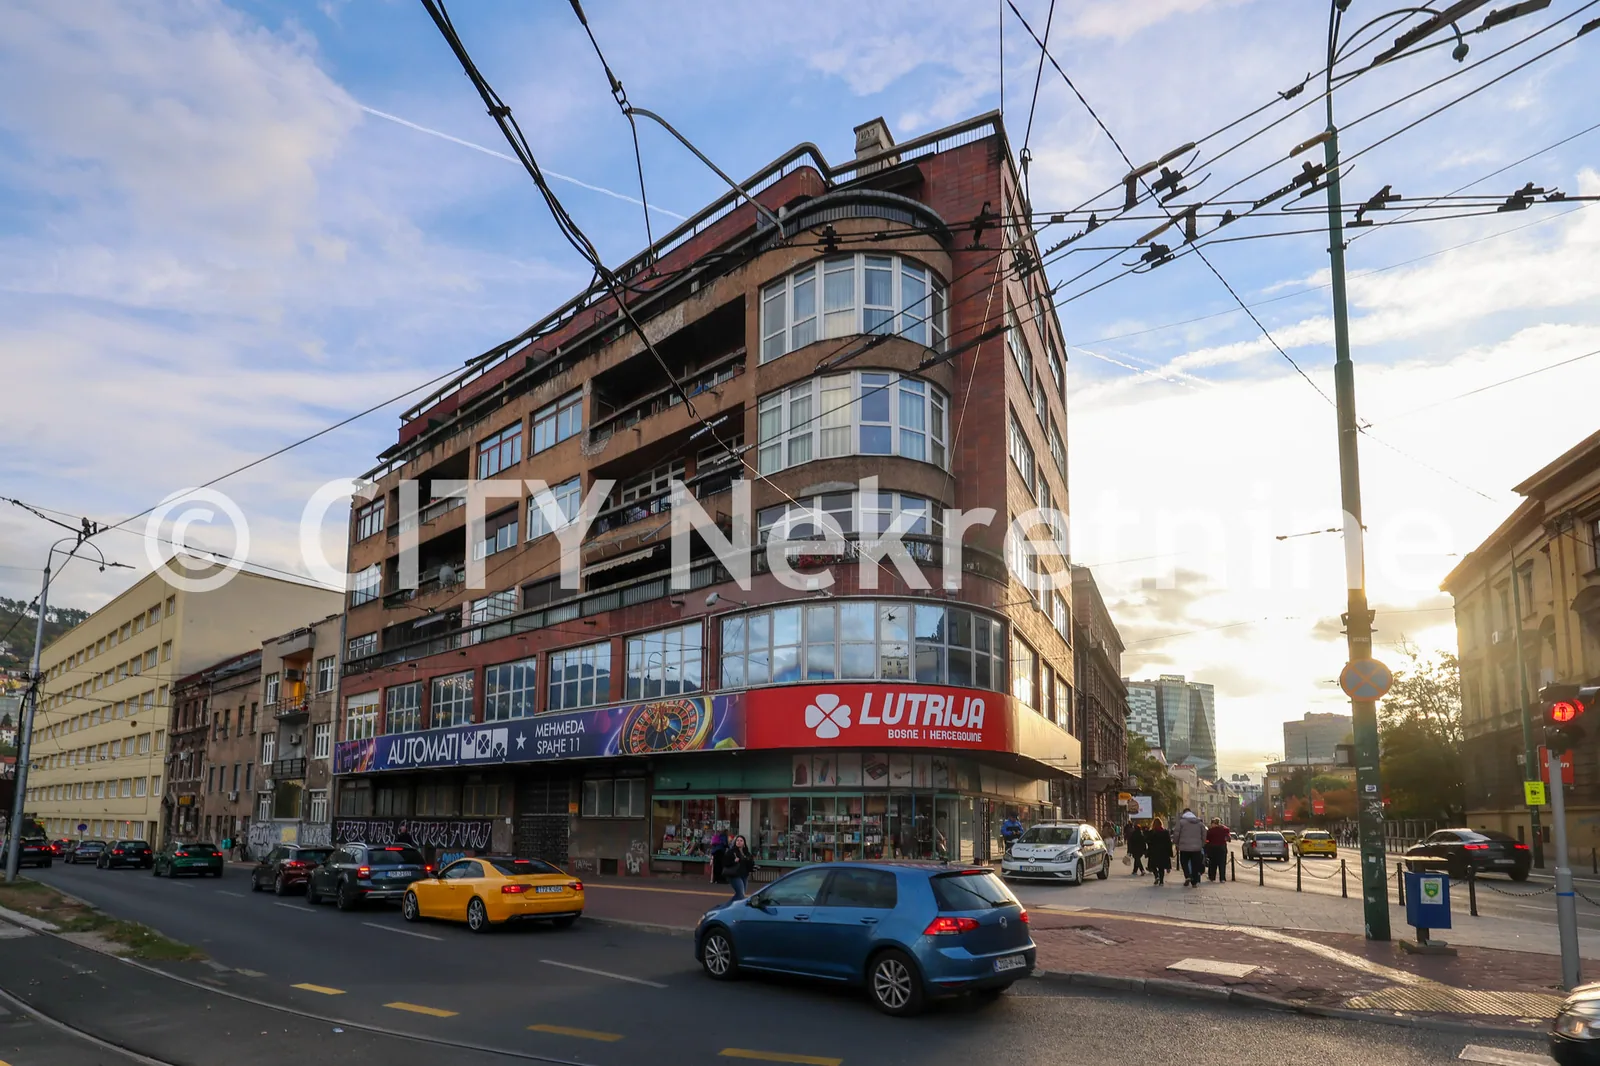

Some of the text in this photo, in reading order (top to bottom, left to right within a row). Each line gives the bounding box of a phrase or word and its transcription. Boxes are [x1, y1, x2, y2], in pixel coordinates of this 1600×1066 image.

[858, 692, 986, 729] LUTRIJA
[535, 719, 585, 737] MEHMEDA
[387, 733, 459, 765] AUTOMATI
[537, 737, 581, 755] SPAHE 11
